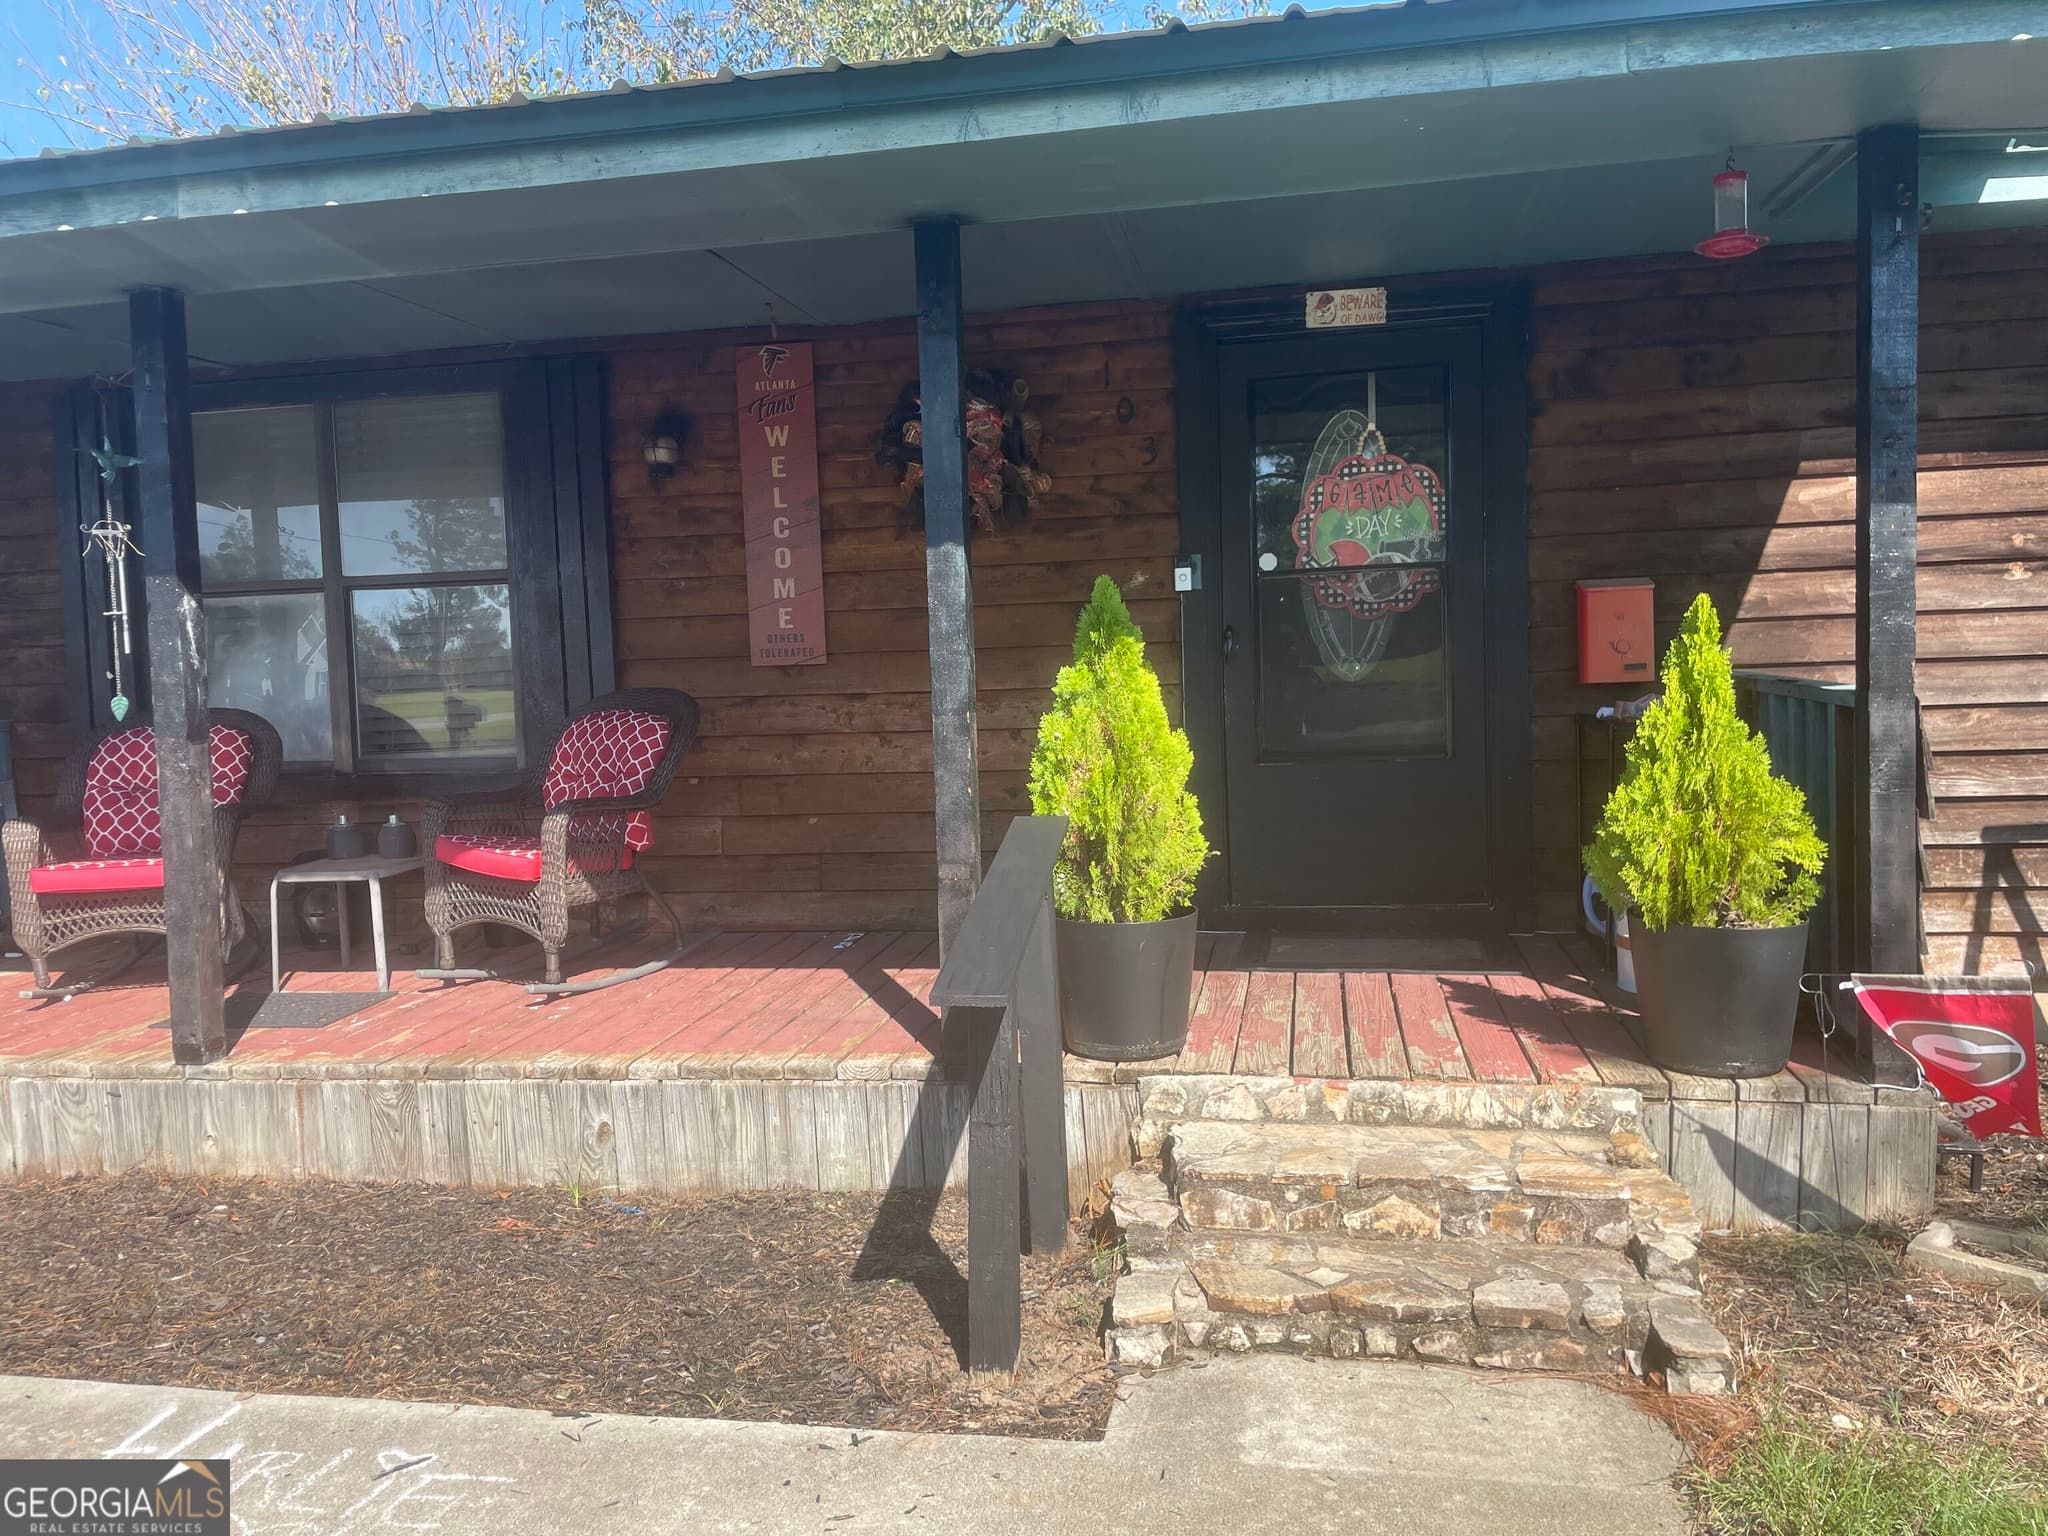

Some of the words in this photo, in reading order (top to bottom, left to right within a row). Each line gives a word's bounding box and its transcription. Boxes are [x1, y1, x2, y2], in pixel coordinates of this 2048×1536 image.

[1340, 291, 1384, 311] BEWARE
[1341, 314, 1353, 324] OF
[1355, 311, 1384, 323] DAWG
[754, 379, 796, 392] ATLANTA
[749, 393, 798, 424] Fans
[764, 425, 795, 629] WELCOME
[1356, 509, 1392, 539] DAY
[767, 633, 805, 644] OTHERS
[760, 647, 815, 658] TOLERATED
